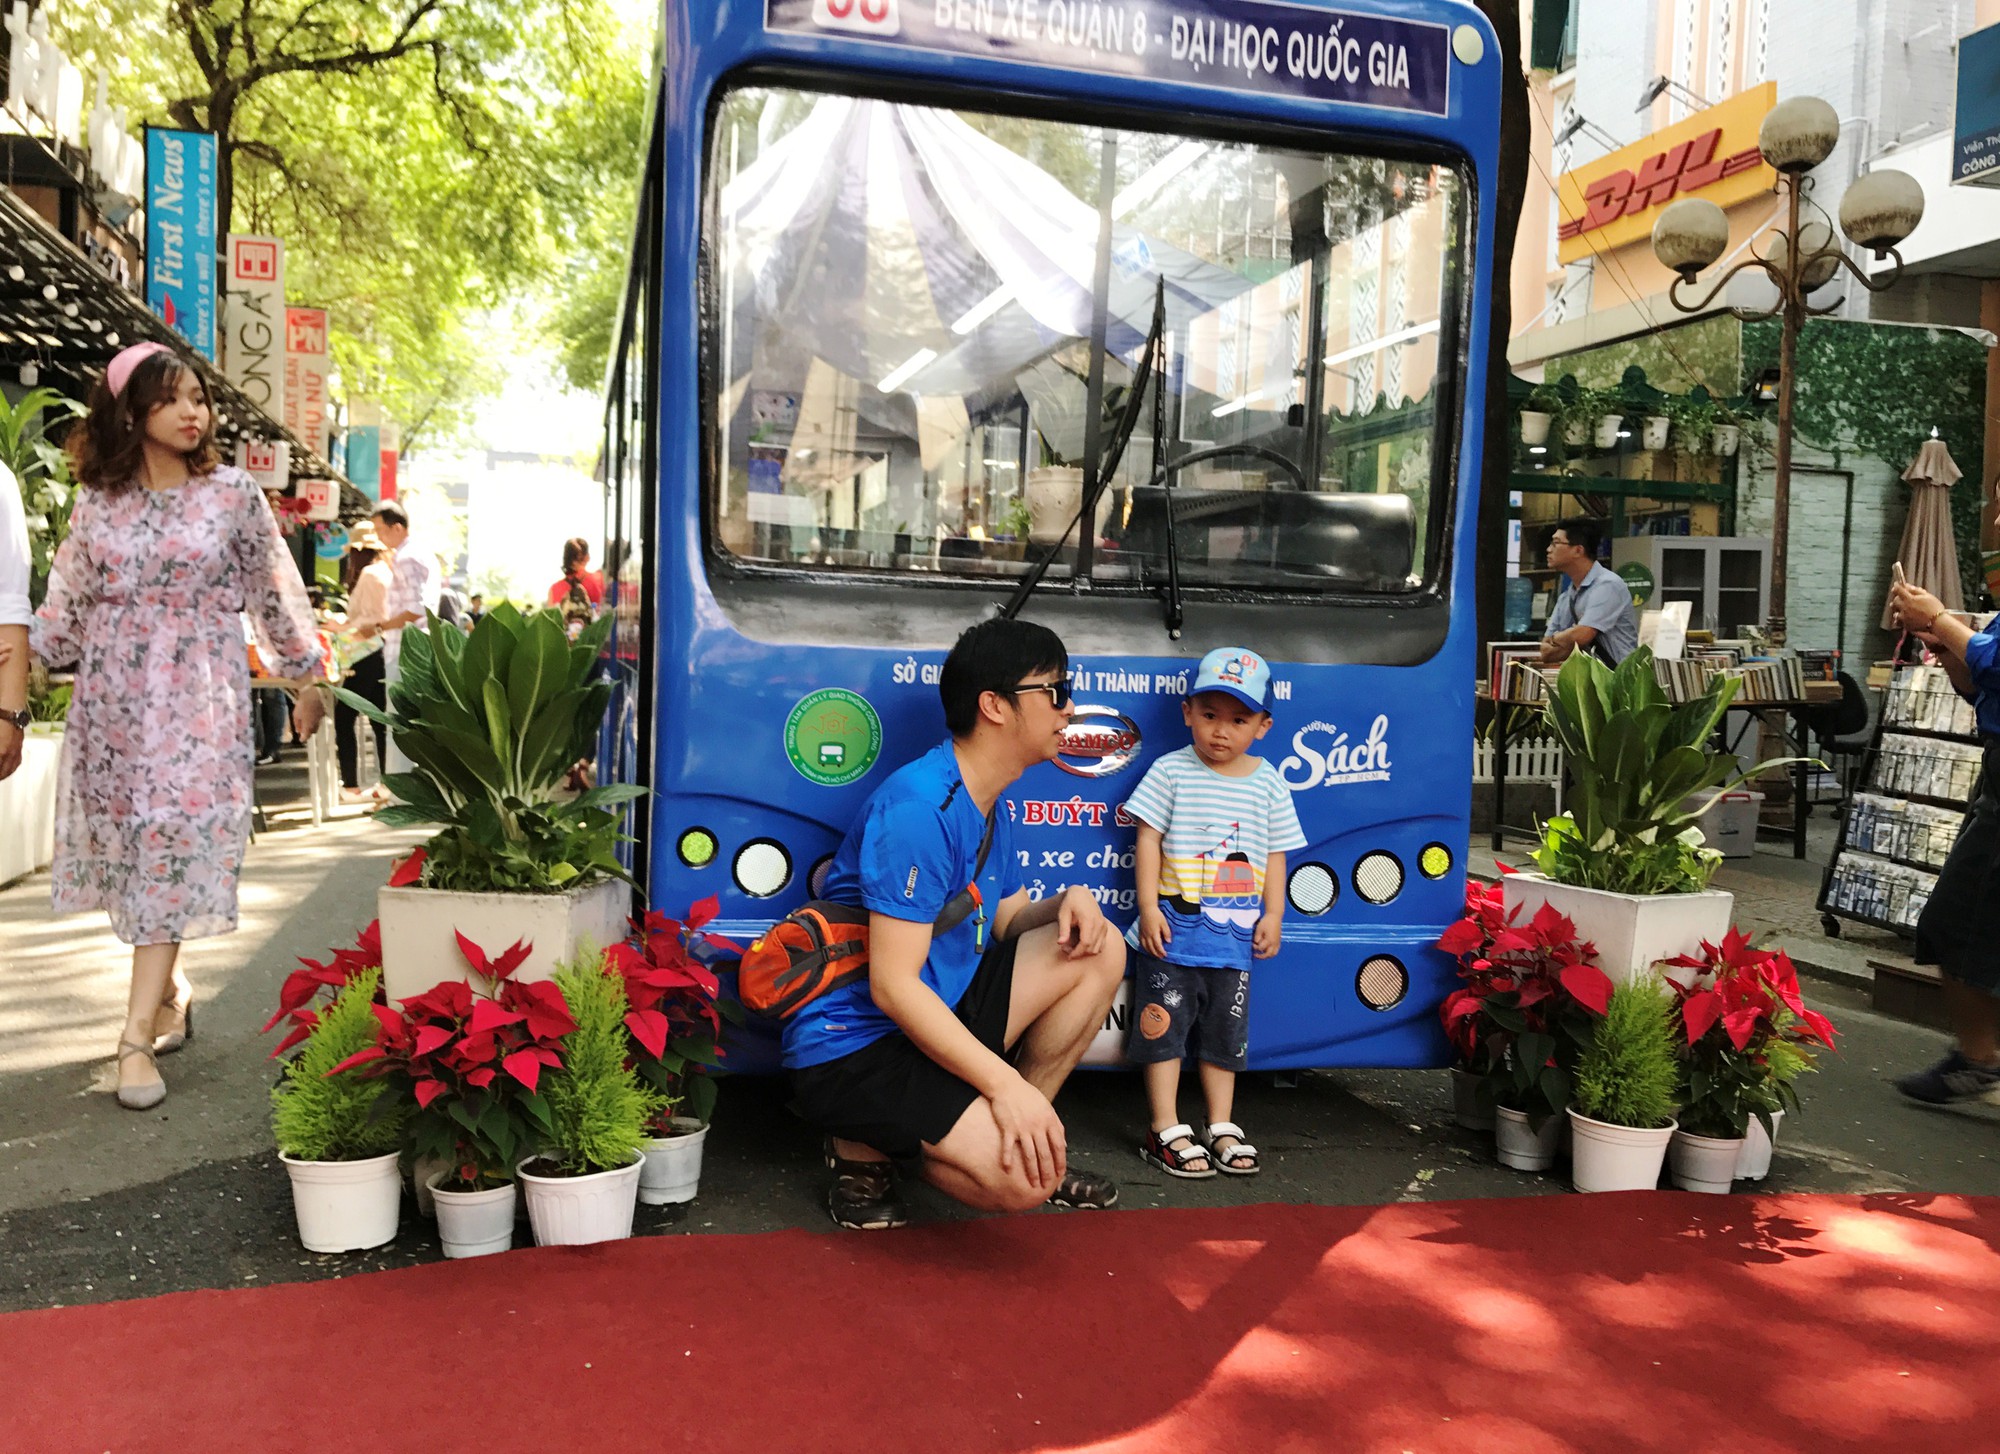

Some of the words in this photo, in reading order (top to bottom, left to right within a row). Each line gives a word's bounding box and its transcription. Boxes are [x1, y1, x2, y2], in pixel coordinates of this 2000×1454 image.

[1002, 0, 1037, 38] XE
[1132, 11, 1147, 56] 8
[1171, 15, 1215, 72] ĐẠI
[1223, 23, 1279, 79] HỌC
[1287, 19, 1361, 83] QUỐC
[1368, 41, 1410, 90] GIA
[1579, 128, 1726, 233] DHL
[154, 221, 184, 289] First
[893, 656, 917, 684] SỞ
[1095, 668, 1150, 694] THÀNH
[1155, 669, 1190, 695] PHỐ
[1273, 680, 1292, 701] NH
[1278, 714, 1393, 791] Sách
[1022, 795, 1108, 827] BUÝT
[1039, 850, 1076, 868] xe
[1229, 971, 1250, 1019] BOYS
